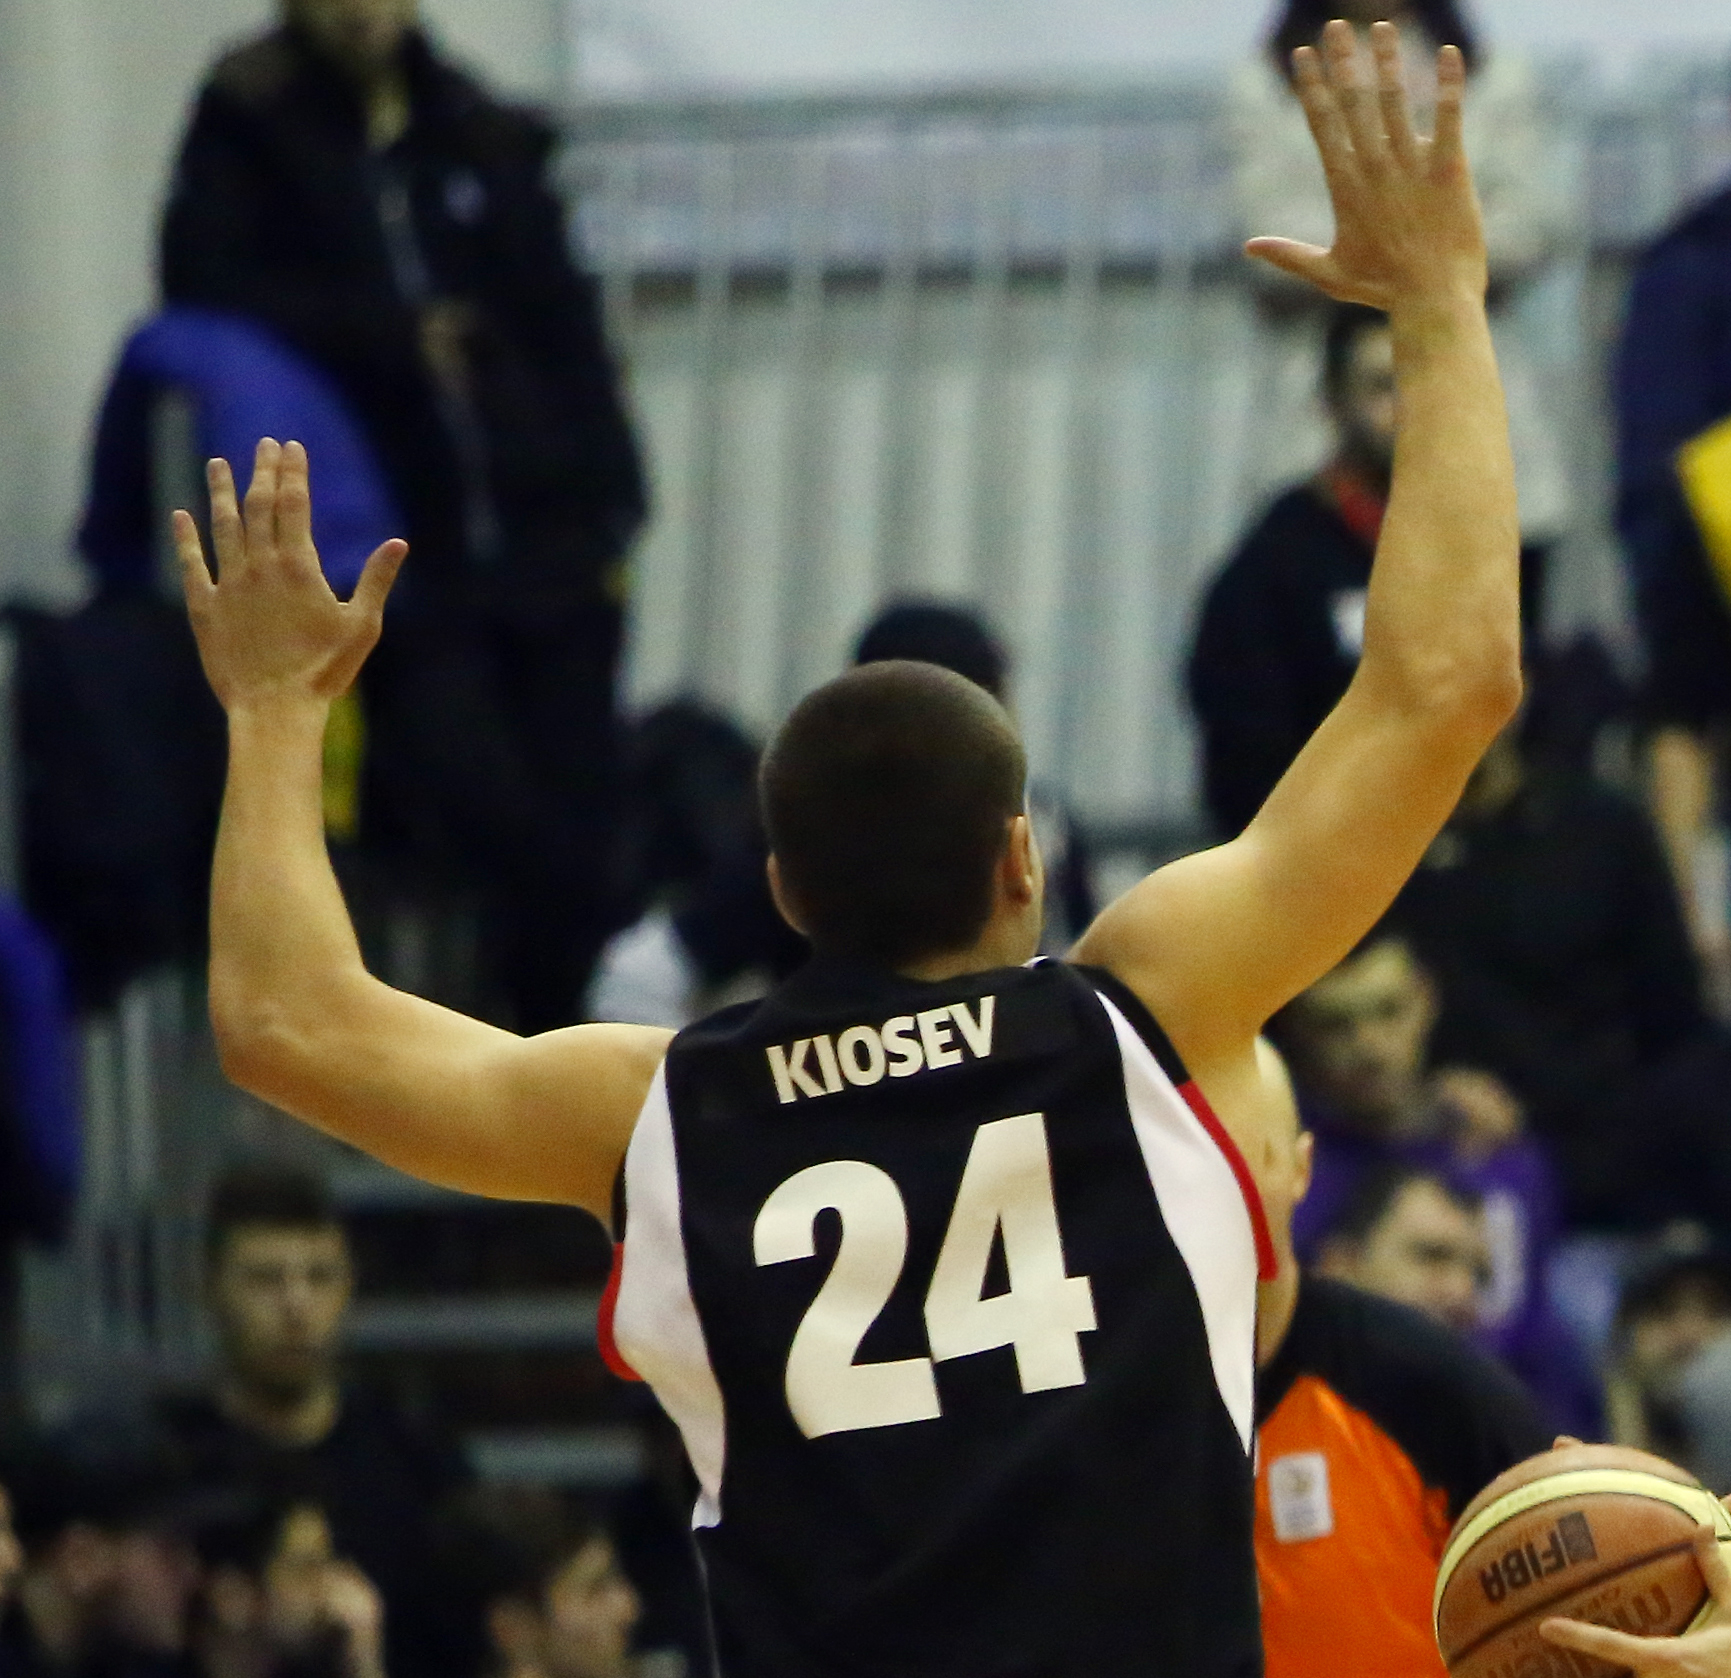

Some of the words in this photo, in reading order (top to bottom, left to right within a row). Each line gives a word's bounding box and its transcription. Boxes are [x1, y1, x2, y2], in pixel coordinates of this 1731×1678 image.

[765, 995, 997, 1104] KIOSEV
[752, 1111, 1098, 1439] 24
[1479, 1529, 1570, 1602] FIBA
